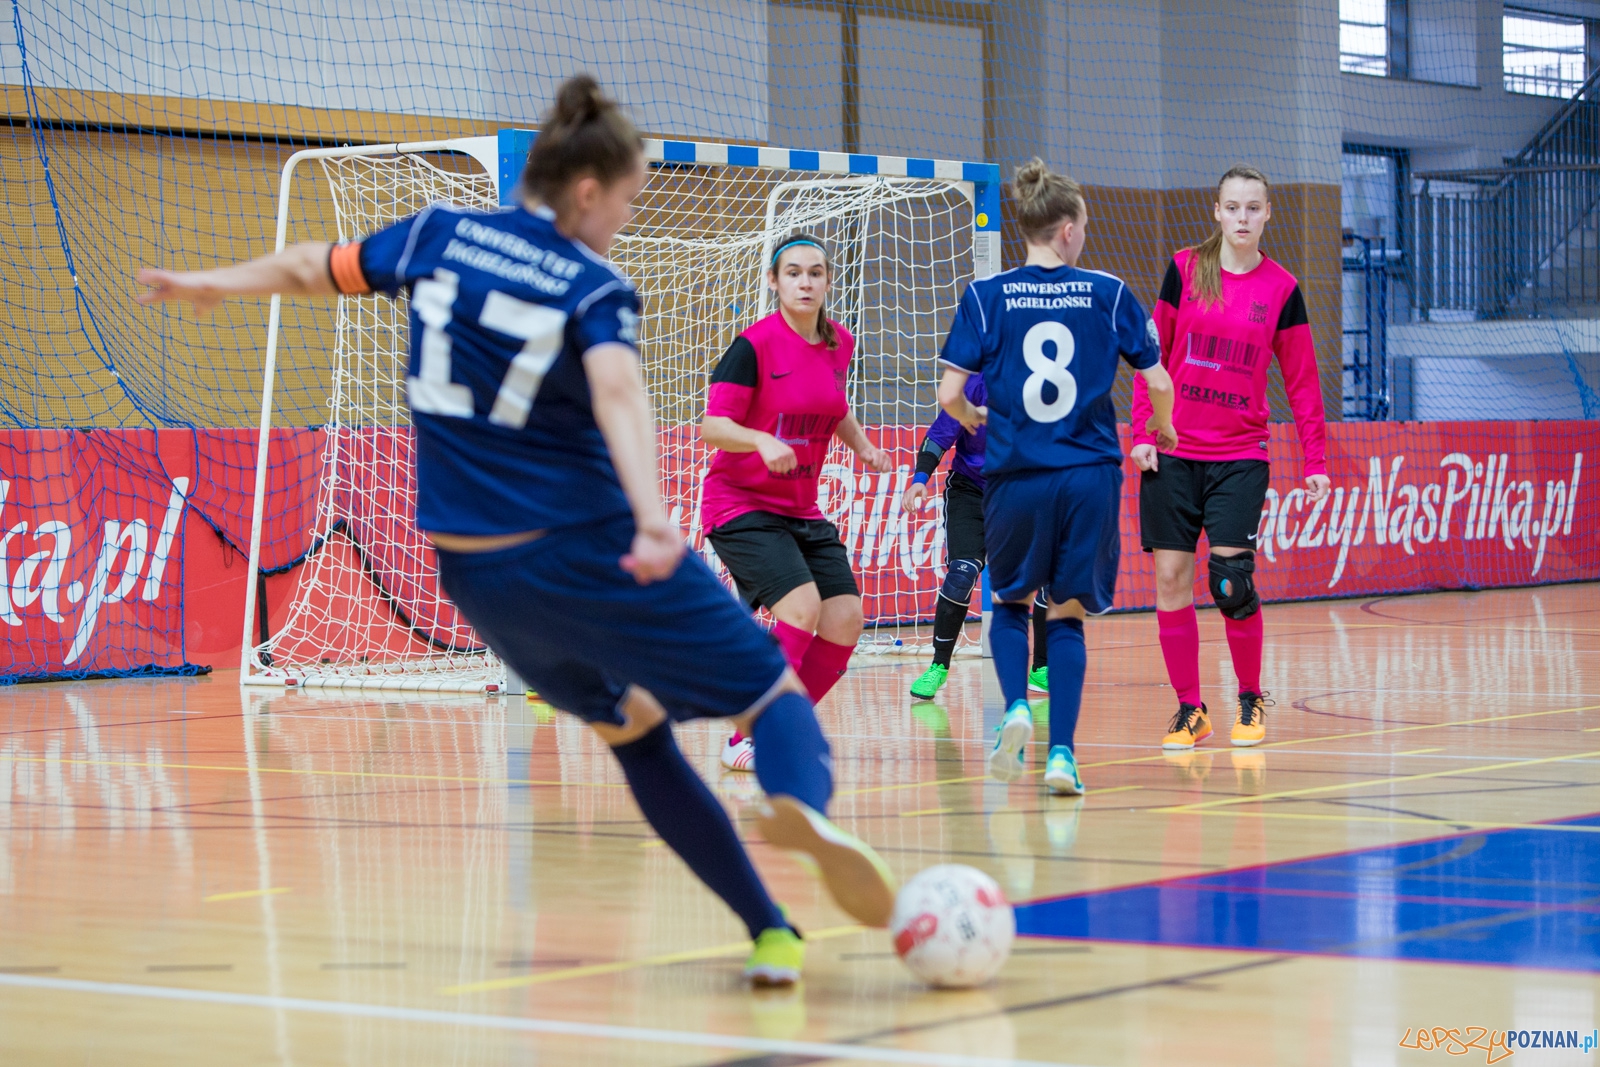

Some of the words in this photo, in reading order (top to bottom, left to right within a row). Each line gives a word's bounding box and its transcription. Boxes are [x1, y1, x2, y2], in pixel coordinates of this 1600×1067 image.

[1002, 281, 1094, 295] UNIWERSYTET
[1005, 295, 1093, 312] JAGIELLOŃSKI
[407, 267, 569, 430] 17
[1022, 320, 1078, 424] 8
[1181, 383, 1251, 407] PRIMEX
[1256, 451, 1584, 589] aczyNasPilka.pl
